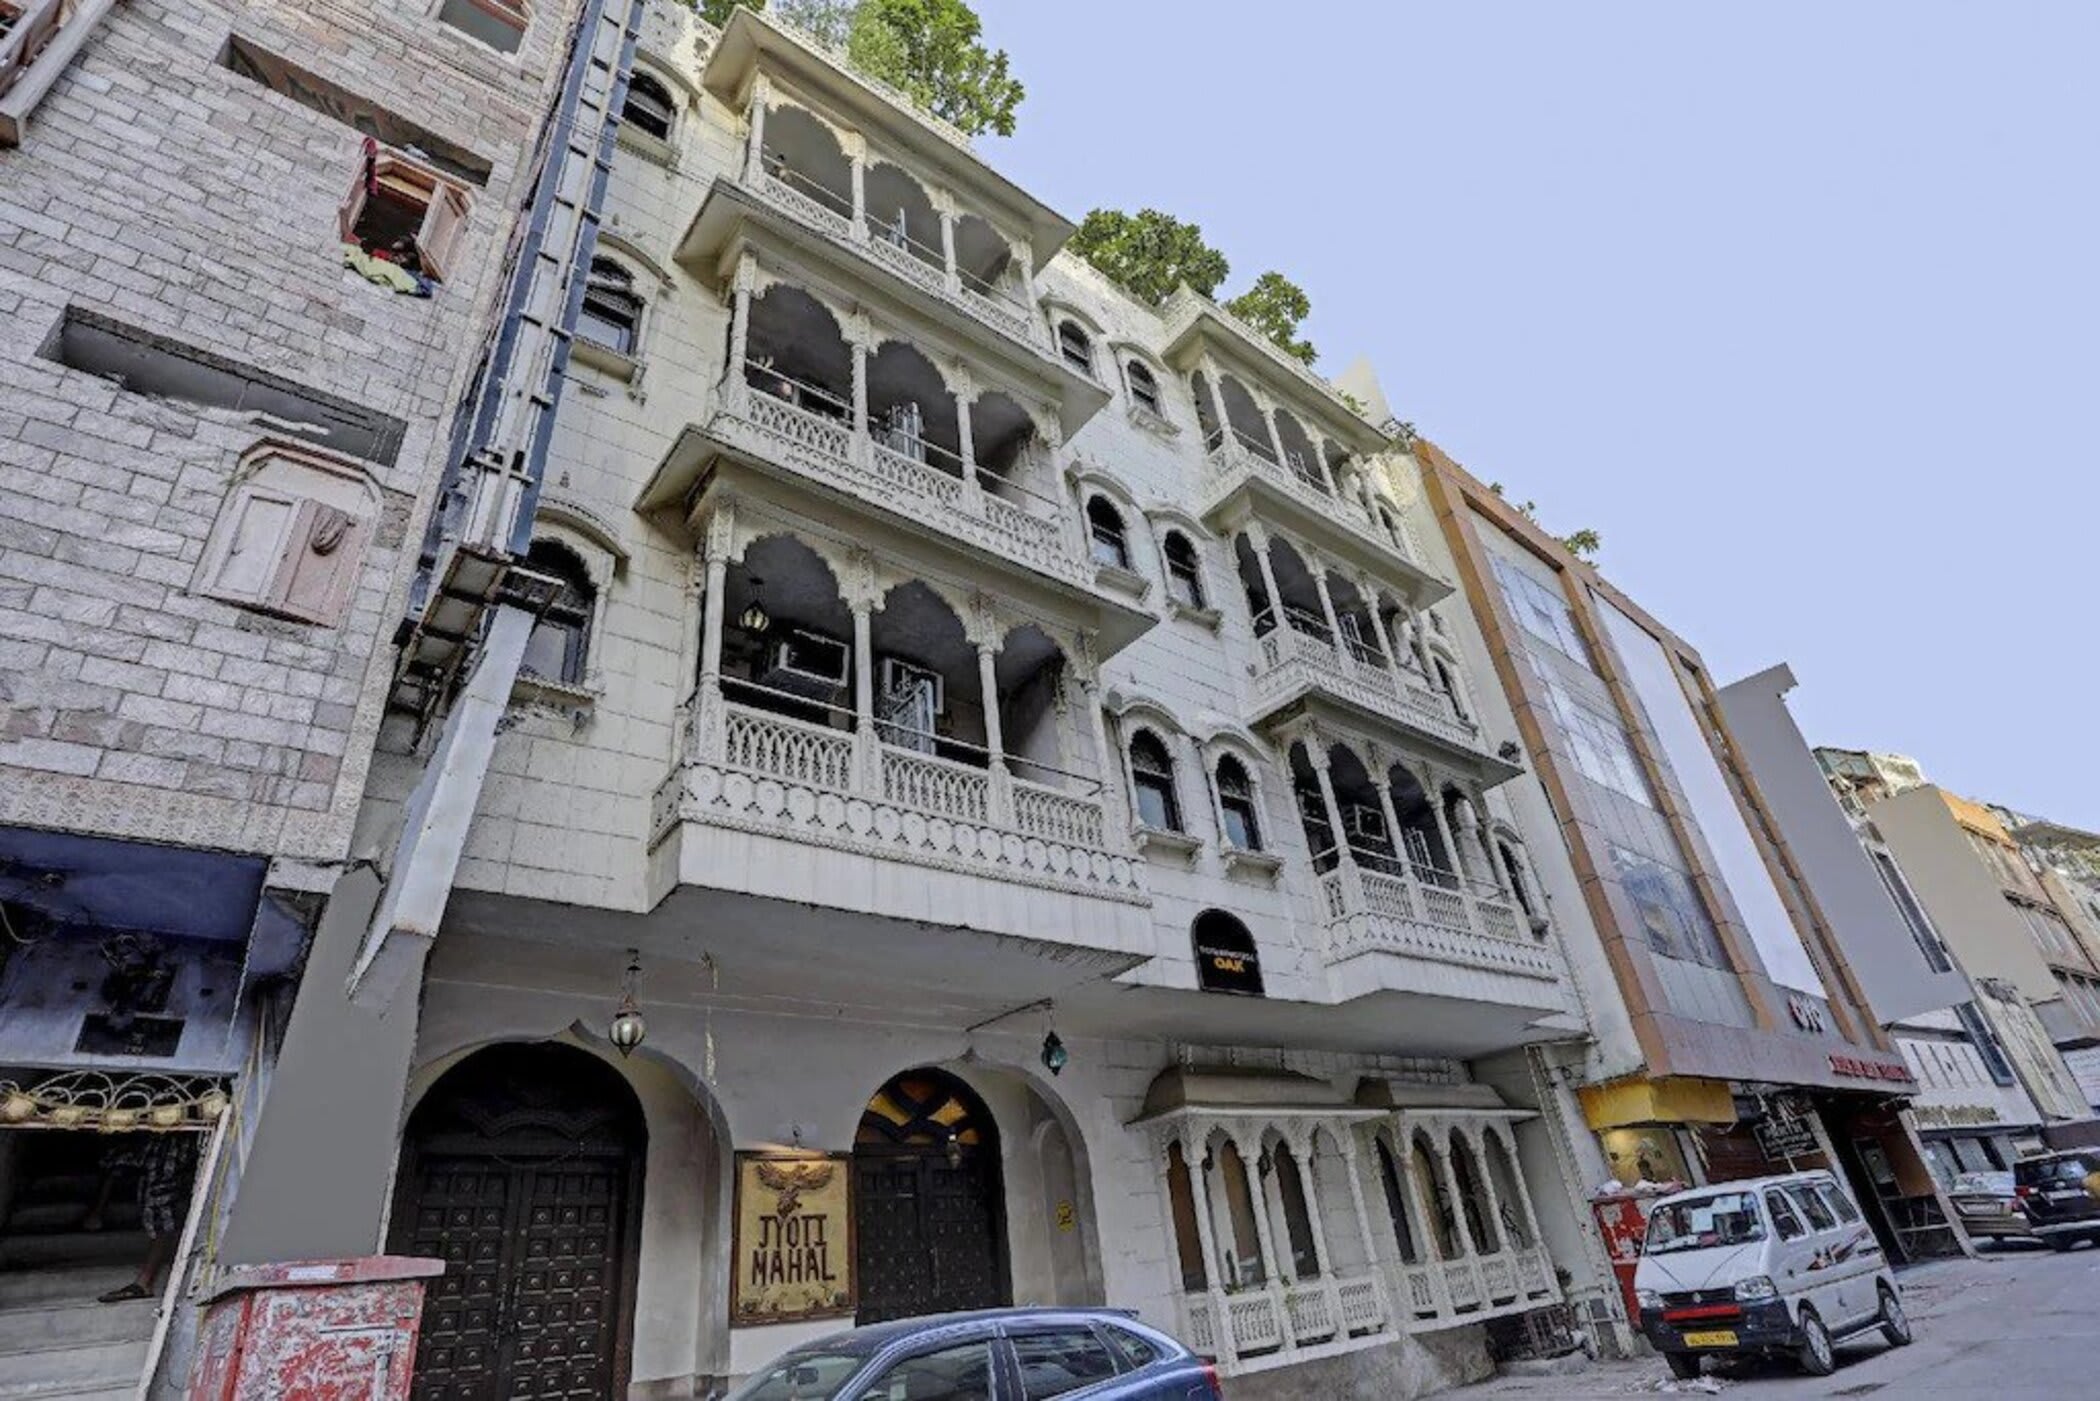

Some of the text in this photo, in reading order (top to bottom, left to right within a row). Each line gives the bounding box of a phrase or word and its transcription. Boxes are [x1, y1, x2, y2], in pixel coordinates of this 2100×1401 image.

[1214, 957, 1245, 972] OAK
[759, 1214, 827, 1248] JYOTI
[752, 1249, 836, 1285] MAHAL
